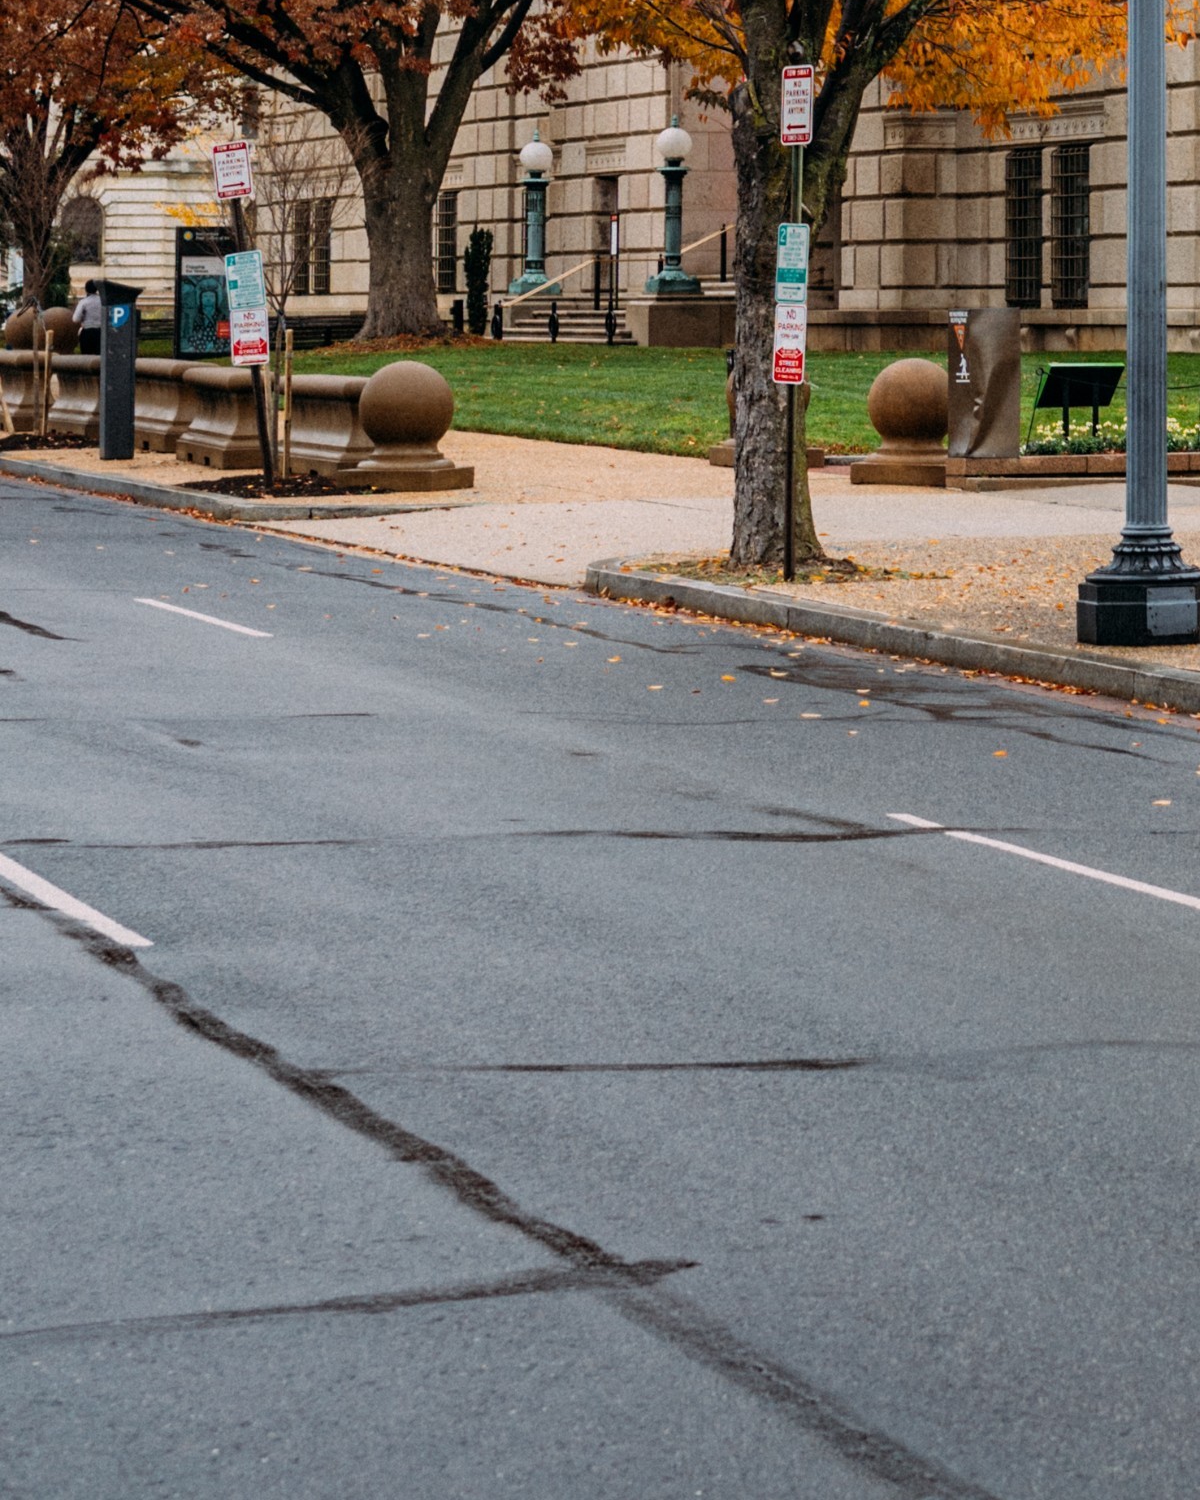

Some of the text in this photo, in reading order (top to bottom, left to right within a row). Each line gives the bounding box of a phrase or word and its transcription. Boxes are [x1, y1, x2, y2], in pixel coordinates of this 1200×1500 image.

[793, 80, 802, 88] NO
[786, 89, 808, 97] PARKING
[218, 157, 245, 165] PARKING
[780, 228, 786, 243] 2
[114, 307, 125, 324] P
[243, 312, 256, 320] NO
[787, 310, 797, 320] NO
[778, 322, 804, 332] PARKING
[238, 348, 263, 356] STREET
[775, 366, 802, 374] CLEANING
